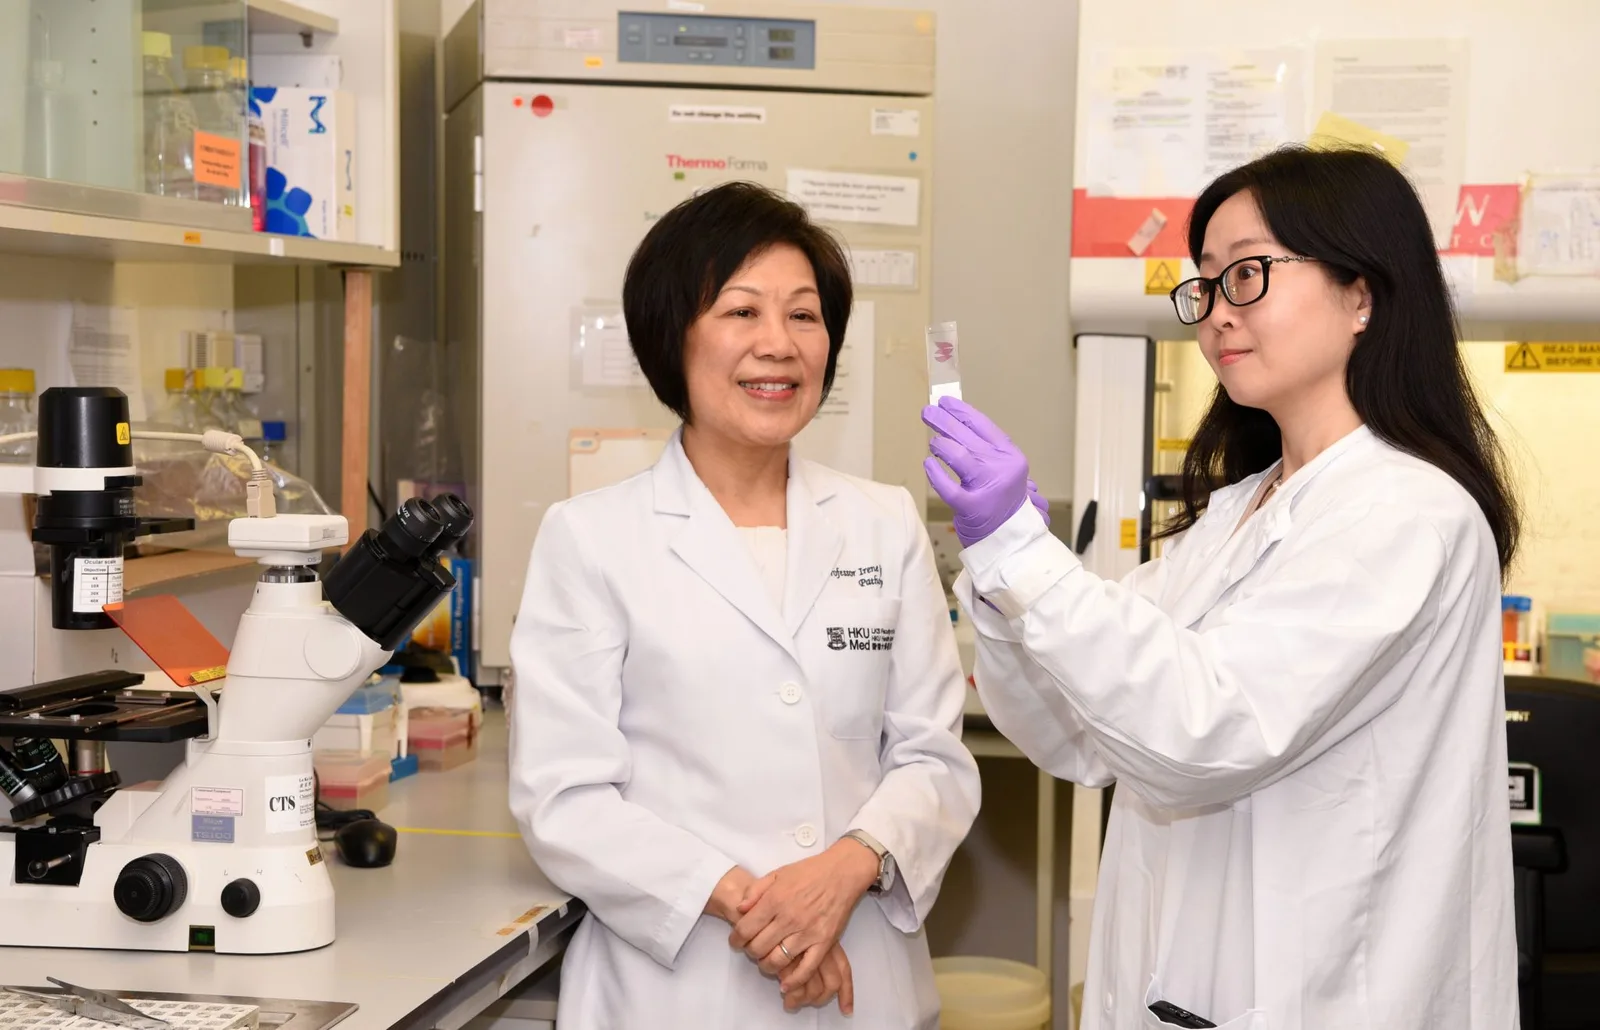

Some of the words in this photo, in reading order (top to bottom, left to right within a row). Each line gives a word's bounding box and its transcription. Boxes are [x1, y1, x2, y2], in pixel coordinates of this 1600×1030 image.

[666, 154, 726, 170] Thermo
[728, 156, 768, 172] Forma
[847, 627, 870, 639] HKU
[849, 639, 871, 651] Med
[269, 795, 296, 812] CTS
